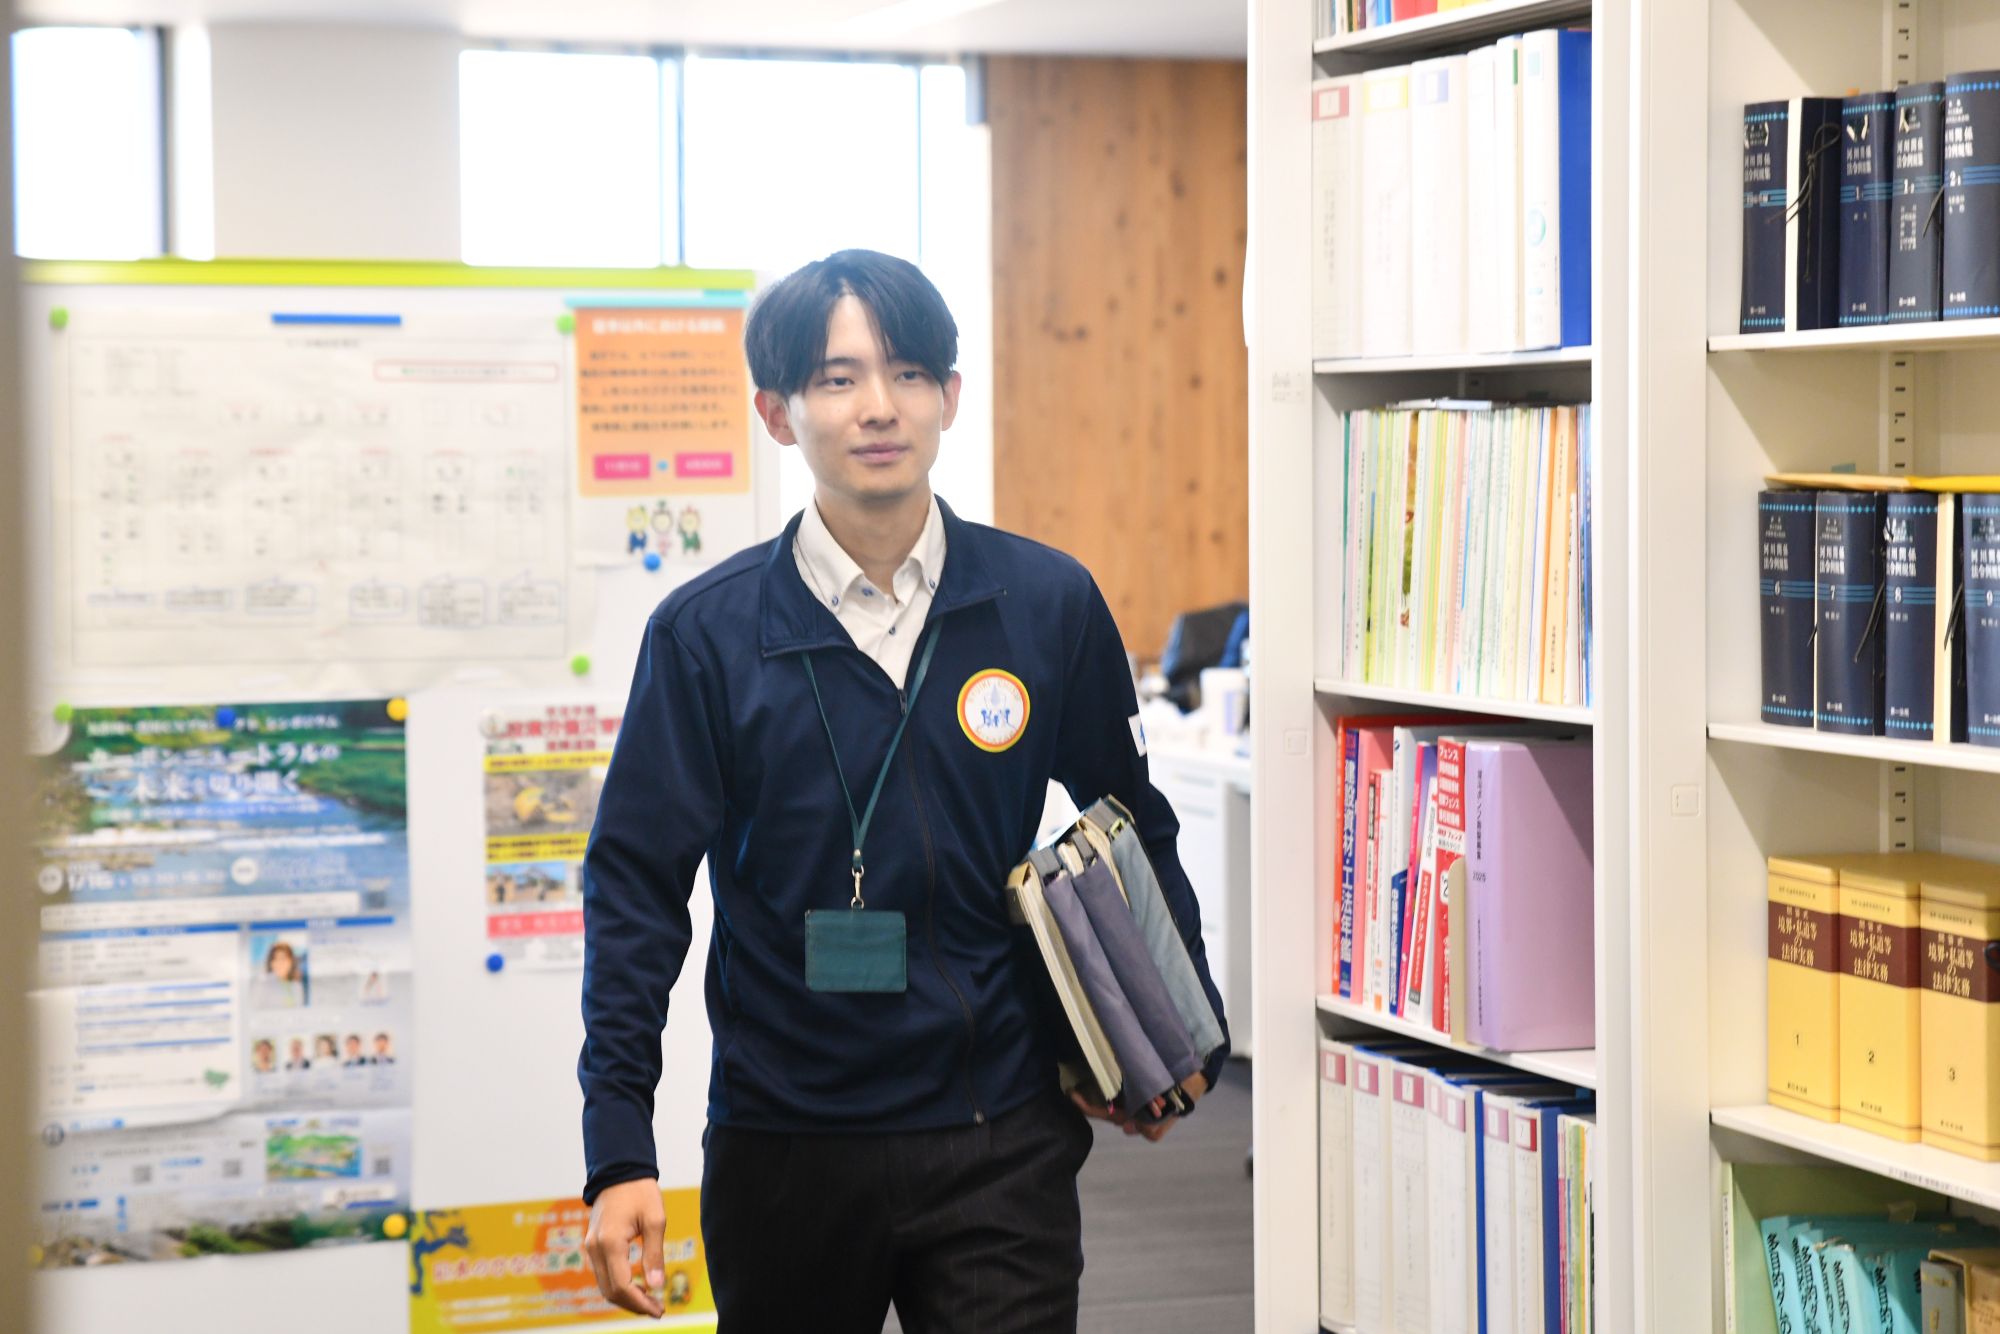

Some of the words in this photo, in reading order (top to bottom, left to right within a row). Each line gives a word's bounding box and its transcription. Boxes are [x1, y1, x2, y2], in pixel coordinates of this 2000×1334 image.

[1774, 580, 1781, 596] 6
[1830, 585, 1836, 601] 7
[1894, 586, 1902, 603] 8
[1986, 590, 1993, 607] 9
[1794, 1034, 1799, 1046] 1
[1867, 1049, 1875, 1064] 2
[1948, 1067, 1956, 1082] 3
